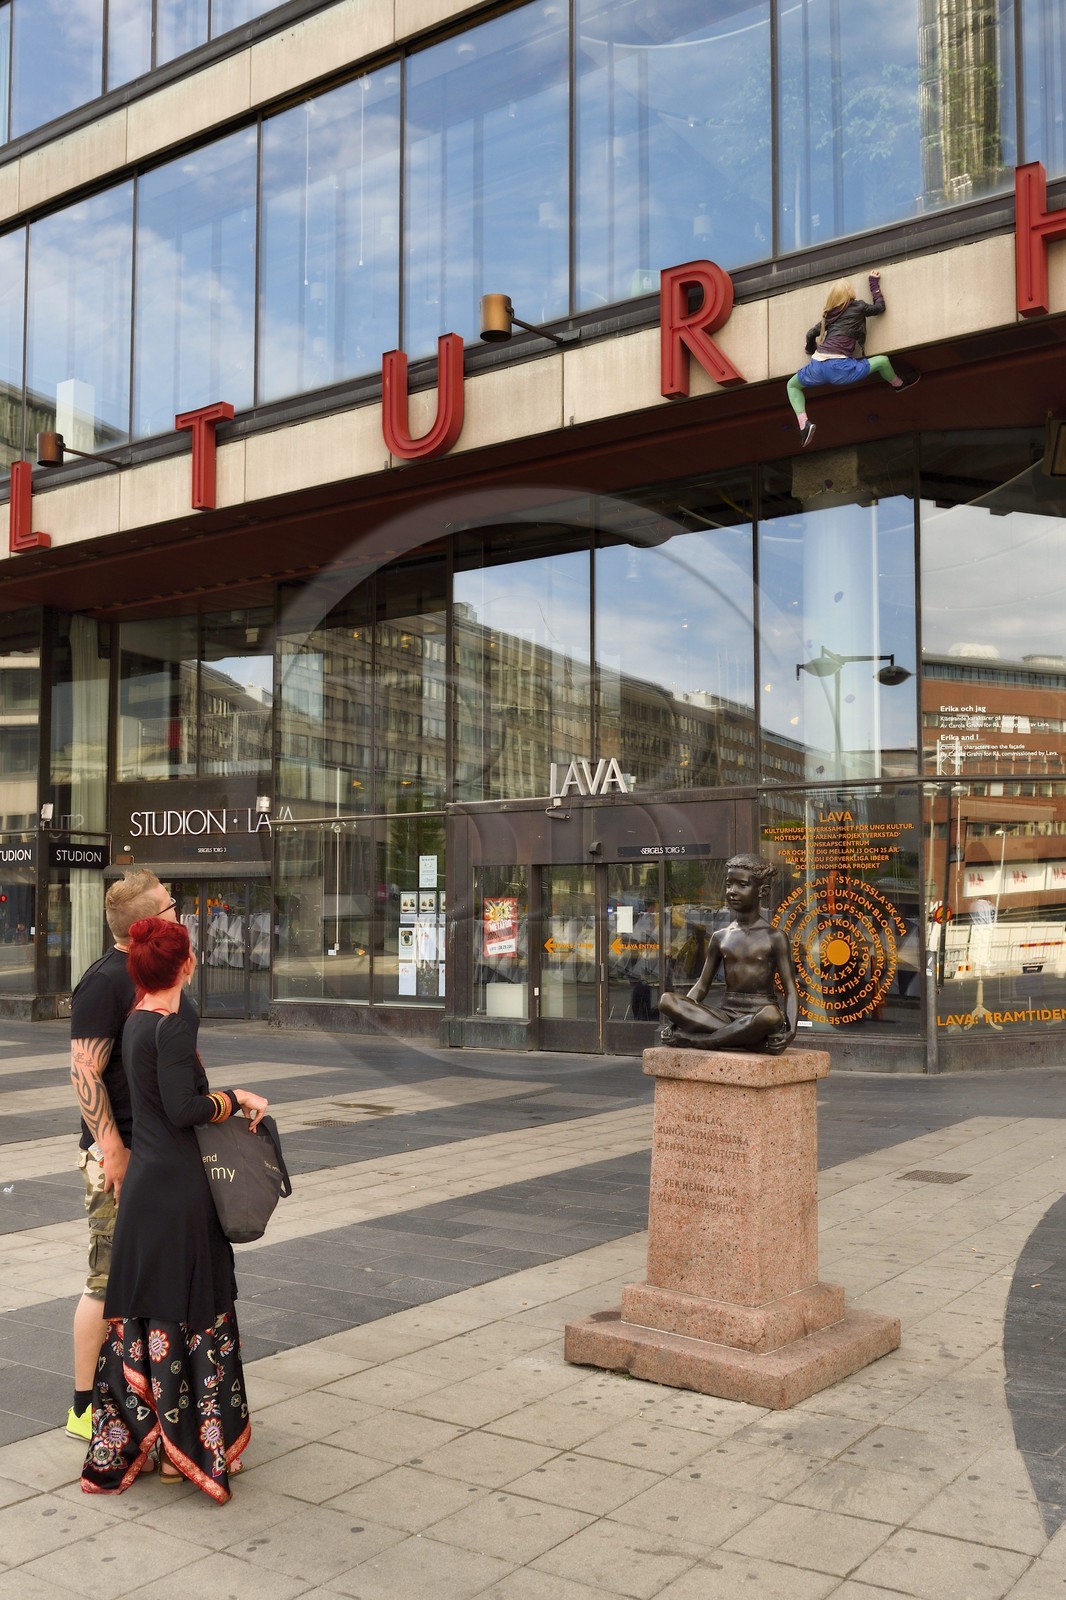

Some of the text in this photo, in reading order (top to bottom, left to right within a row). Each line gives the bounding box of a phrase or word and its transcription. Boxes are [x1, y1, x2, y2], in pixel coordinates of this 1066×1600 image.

[975, 705, 986, 713] jag
[550, 757, 628, 797] LAVA
[129, 808, 227, 837] STUDION
[819, 811, 853, 823] LAVA
[856, 823, 869, 831] FÖR
[56, 849, 102, 863] STUDION
[665, 846, 680, 854] TORG
[770, 915, 781, 929] EN
[777, 887, 804, 914] SNABB
[839, 876, 850, 884] SY
[853, 879, 887, 904] PYSSLA
[797, 902, 855, 931] WORKSHOPS
[809, 889, 873, 910] PRODUKTION
[872, 908, 897, 951] BLOGGA
[835, 918, 866, 943] KONST
[819, 931, 859, 981] MUSIK DANS TEXT
[855, 911, 884, 985] SCREENTRYCK
[792, 933, 835, 995] PERFORMANCE
[858, 946, 870, 976] FOTO
[839, 978, 860, 993] FILM
[937, 1012, 979, 1027] LAVA:
[211, 1166, 236, 1182] my
[682, 1181, 715, 1194] HENRIK
